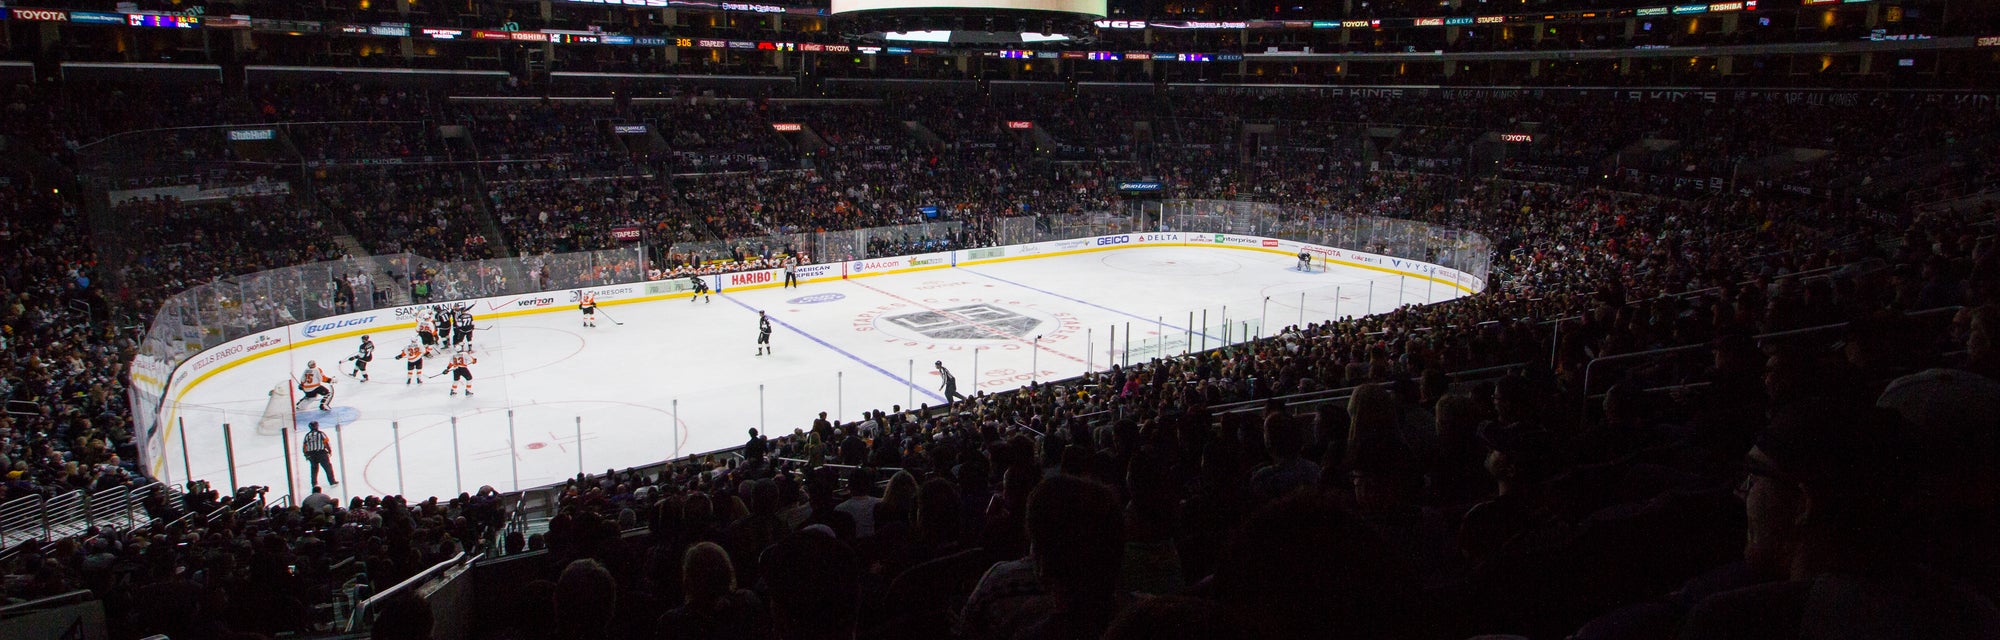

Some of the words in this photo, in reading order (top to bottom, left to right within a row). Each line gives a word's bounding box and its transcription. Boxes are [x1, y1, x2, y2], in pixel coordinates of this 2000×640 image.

[1709, 3, 1742, 11] TOSHIBA
[13, 9, 69, 21] TOYOTA
[1477, 16, 1503, 24] STAPLES
[512, 33, 547, 41] TOSHIBA
[1977, 37, 2000, 47] STAPL
[699, 40, 725, 48] STAPLES
[1650, 91, 1717, 103] KINS
[231, 130, 273, 140] StubHub!
[1501, 134, 1532, 142] TOYOTA
[1097, 235, 1129, 246] GEICO
[864, 260, 899, 269] AAA.com
[732, 271, 771, 286] HARIBO
[601, 287, 633, 296] RESORTS
[518, 296, 554, 307] verizon
[308, 323, 336, 334] BUD
[336, 315, 377, 328] LIGHT
[462, 317, 472, 327] 77
[192, 355, 215, 371] WELLS
[215, 344, 244, 361] FARGO
[977, 370, 1056, 388] TOYOTA
